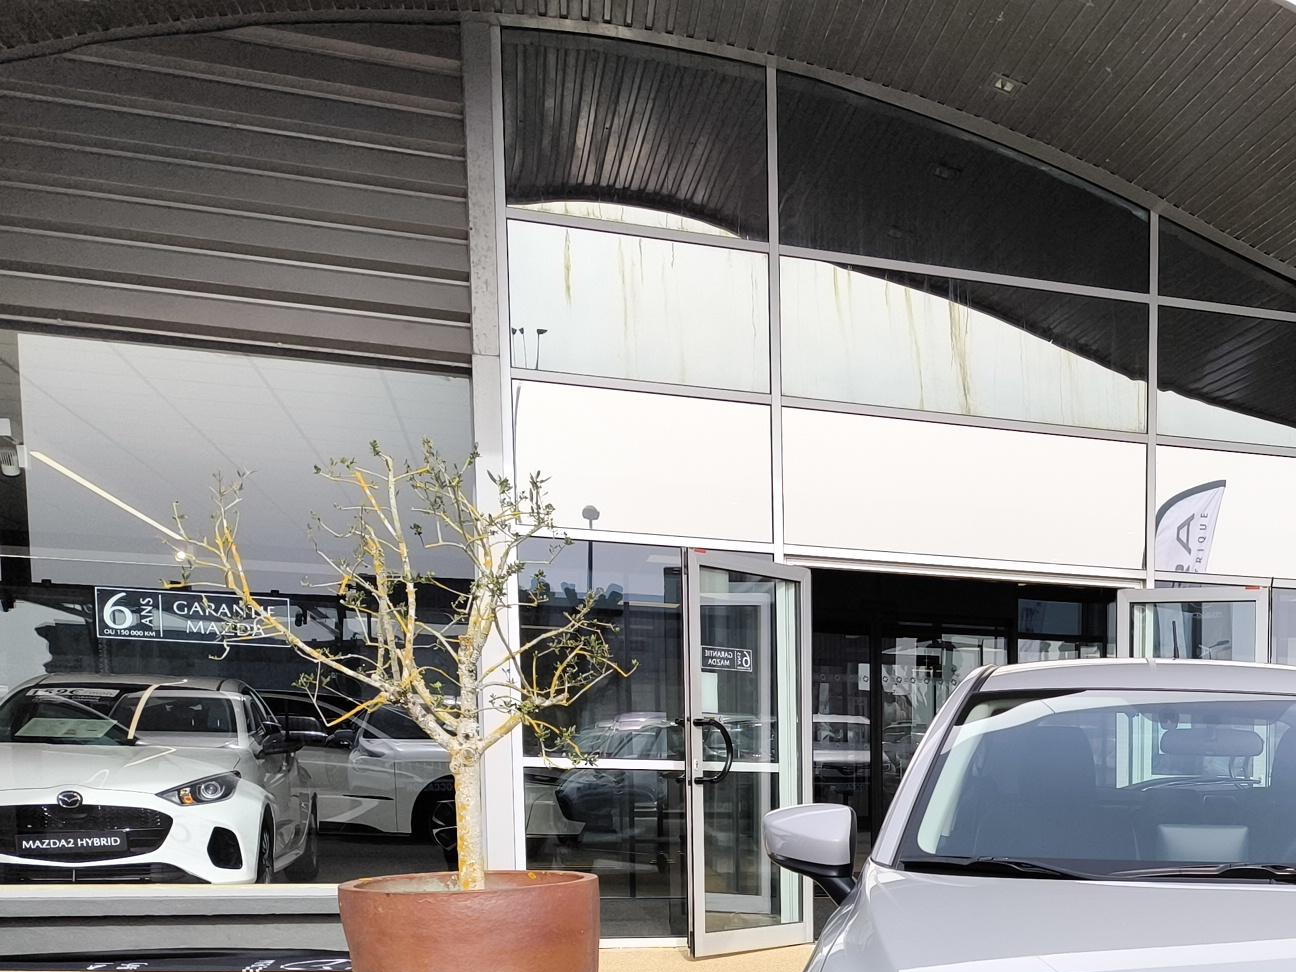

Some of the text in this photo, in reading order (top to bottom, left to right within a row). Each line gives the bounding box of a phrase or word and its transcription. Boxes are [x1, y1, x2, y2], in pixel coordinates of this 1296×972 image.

[1194, 513, 1208, 573] RIQUE
[103, 592, 133, 629] 6
[140, 597, 154, 627] ANS
[173, 600, 276, 619] GARANTIE
[186, 620, 265, 637] MAZDA
[22, 837, 120, 849] MAZDA2 HYBRID
